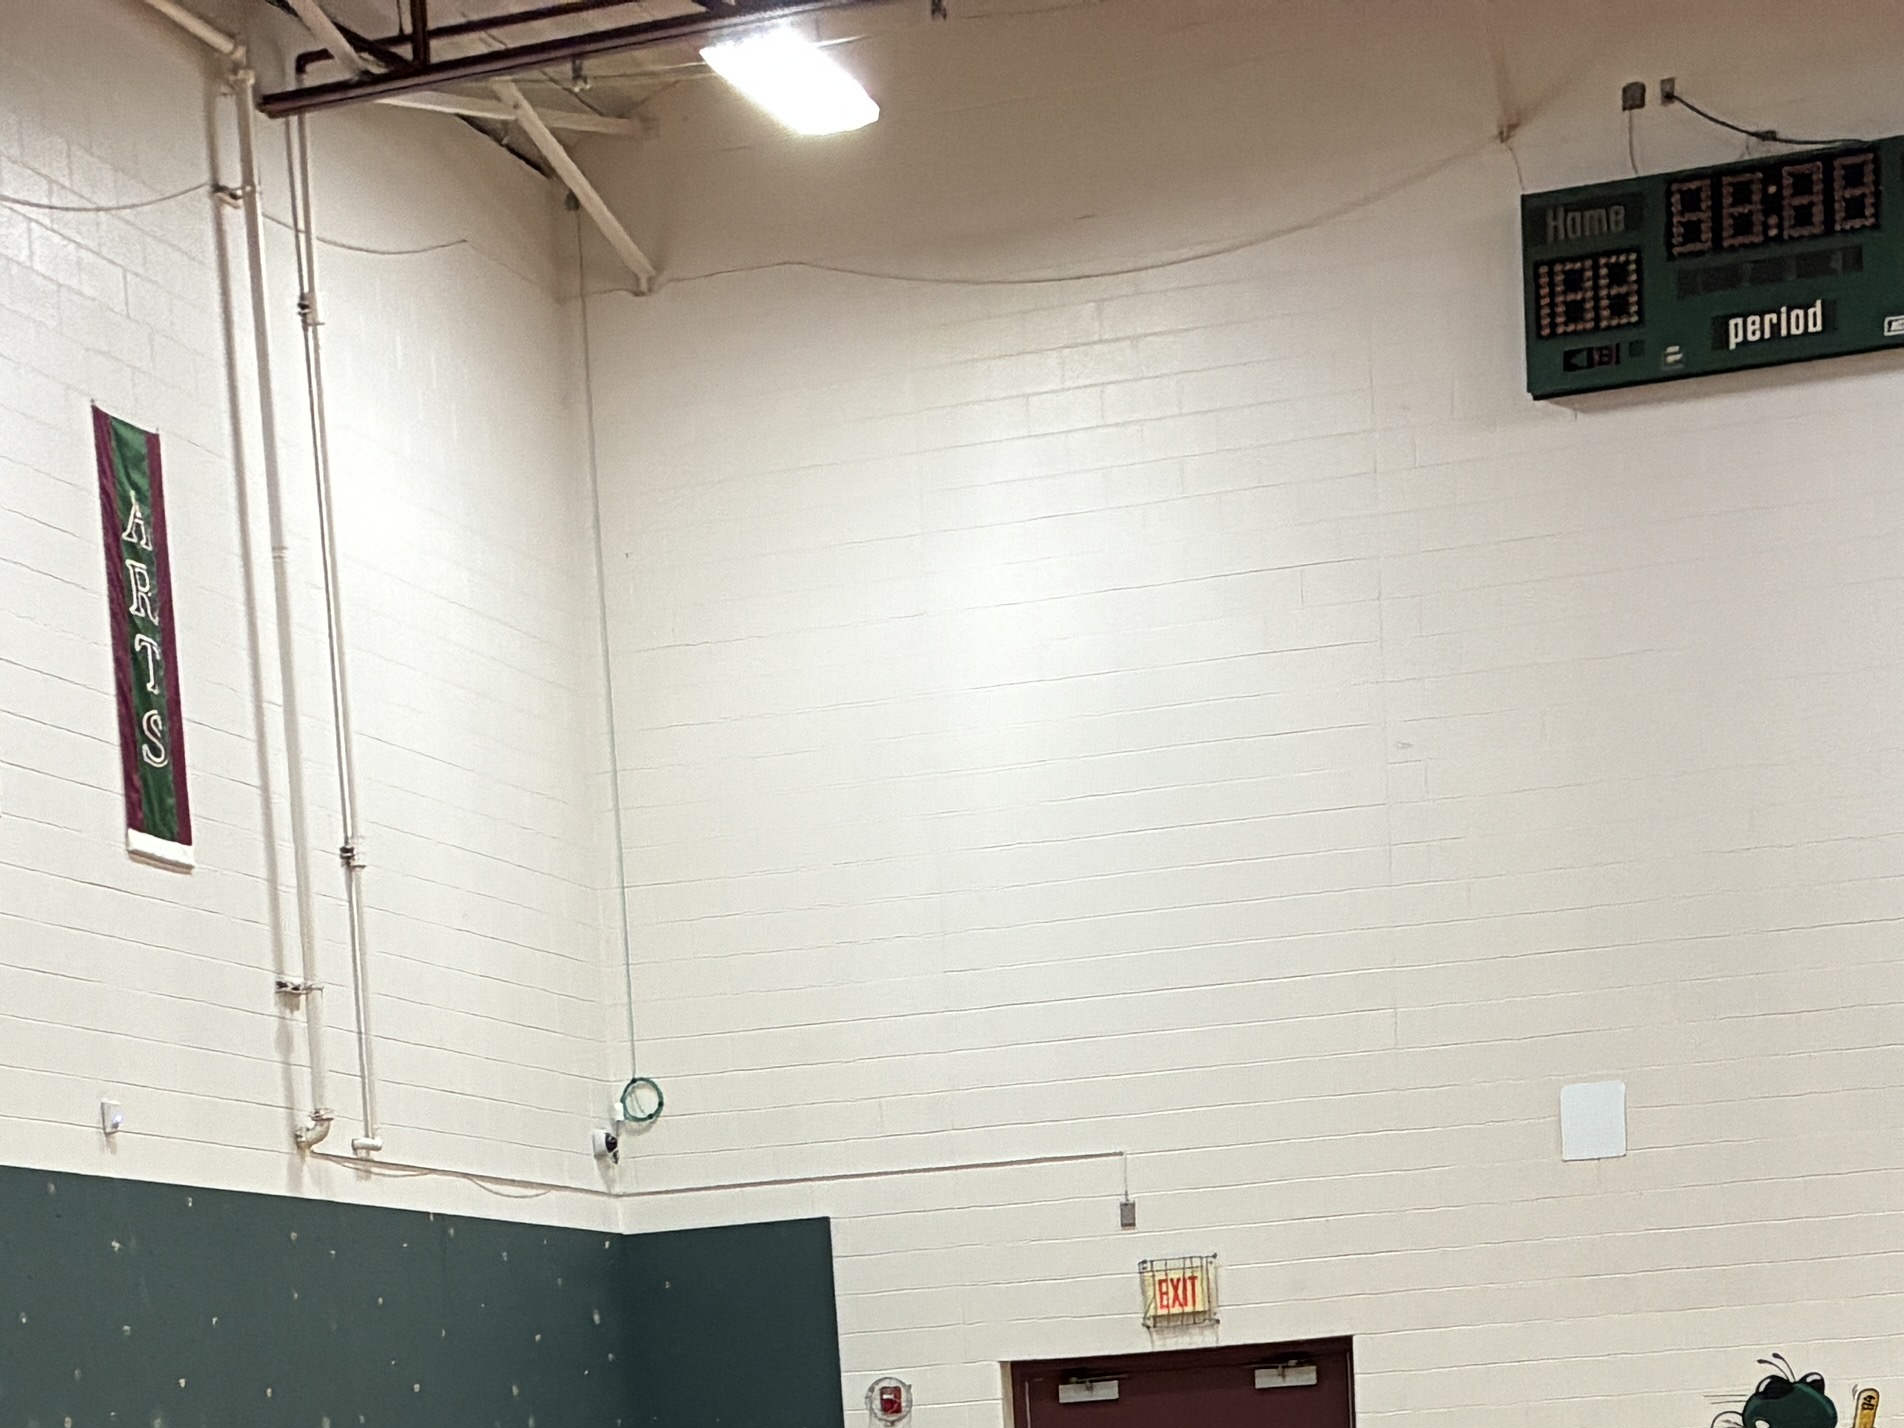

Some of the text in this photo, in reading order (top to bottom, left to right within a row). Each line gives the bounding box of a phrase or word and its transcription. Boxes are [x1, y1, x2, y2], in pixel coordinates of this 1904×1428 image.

[1546, 205, 1626, 244] Home
[1728, 298, 1823, 351] period
[122, 490, 170, 769] ARTS
[1157, 1275, 1199, 1310] EXIT
